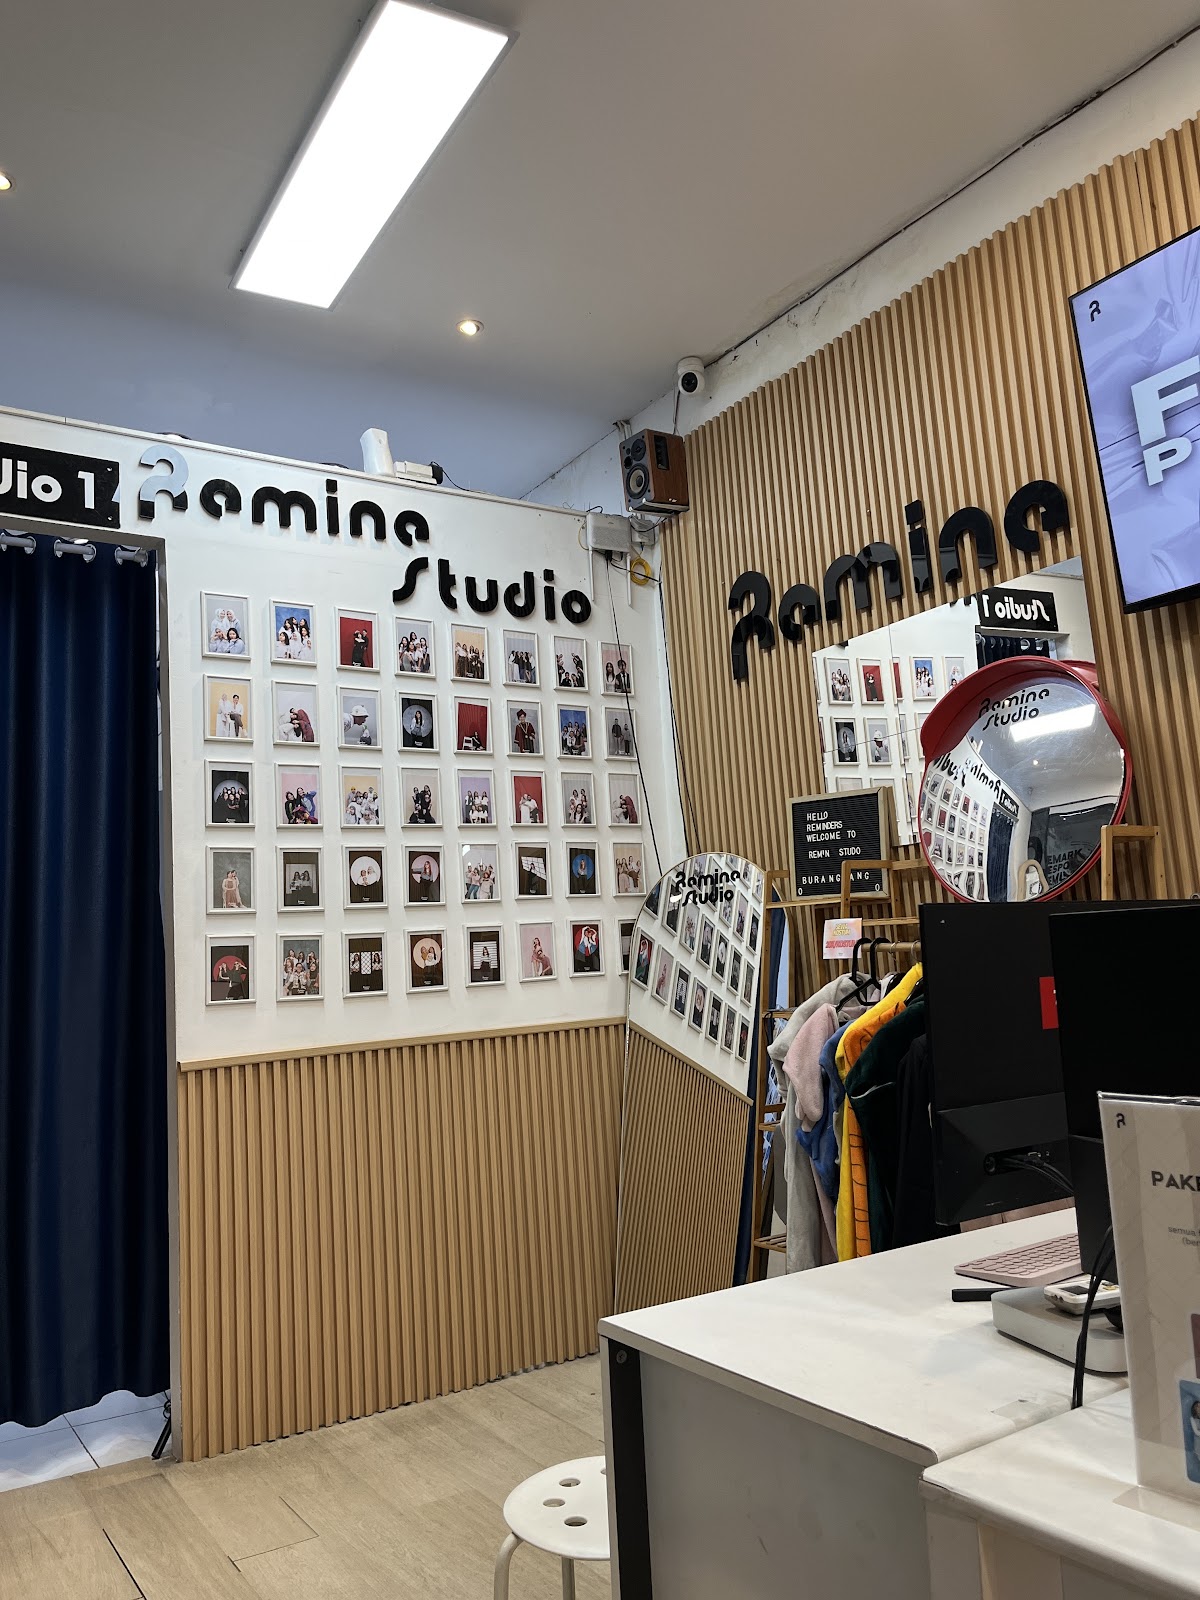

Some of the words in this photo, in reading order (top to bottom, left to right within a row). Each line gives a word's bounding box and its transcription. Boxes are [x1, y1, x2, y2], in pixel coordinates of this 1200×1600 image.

[78, 471, 94, 509] 1
[392, 556, 592, 624] Studio
[982, 706, 1039, 731] Studio
[806, 811, 829, 821] HELLO
[806, 821, 843, 832] REMINDERS
[806, 831, 841, 842] WELCOME
[846, 830, 857, 839] TO
[802, 871, 870, 885] BURANGANG
[682, 886, 734, 907] Studio
[1168, 1226, 1197, 1237] semua
